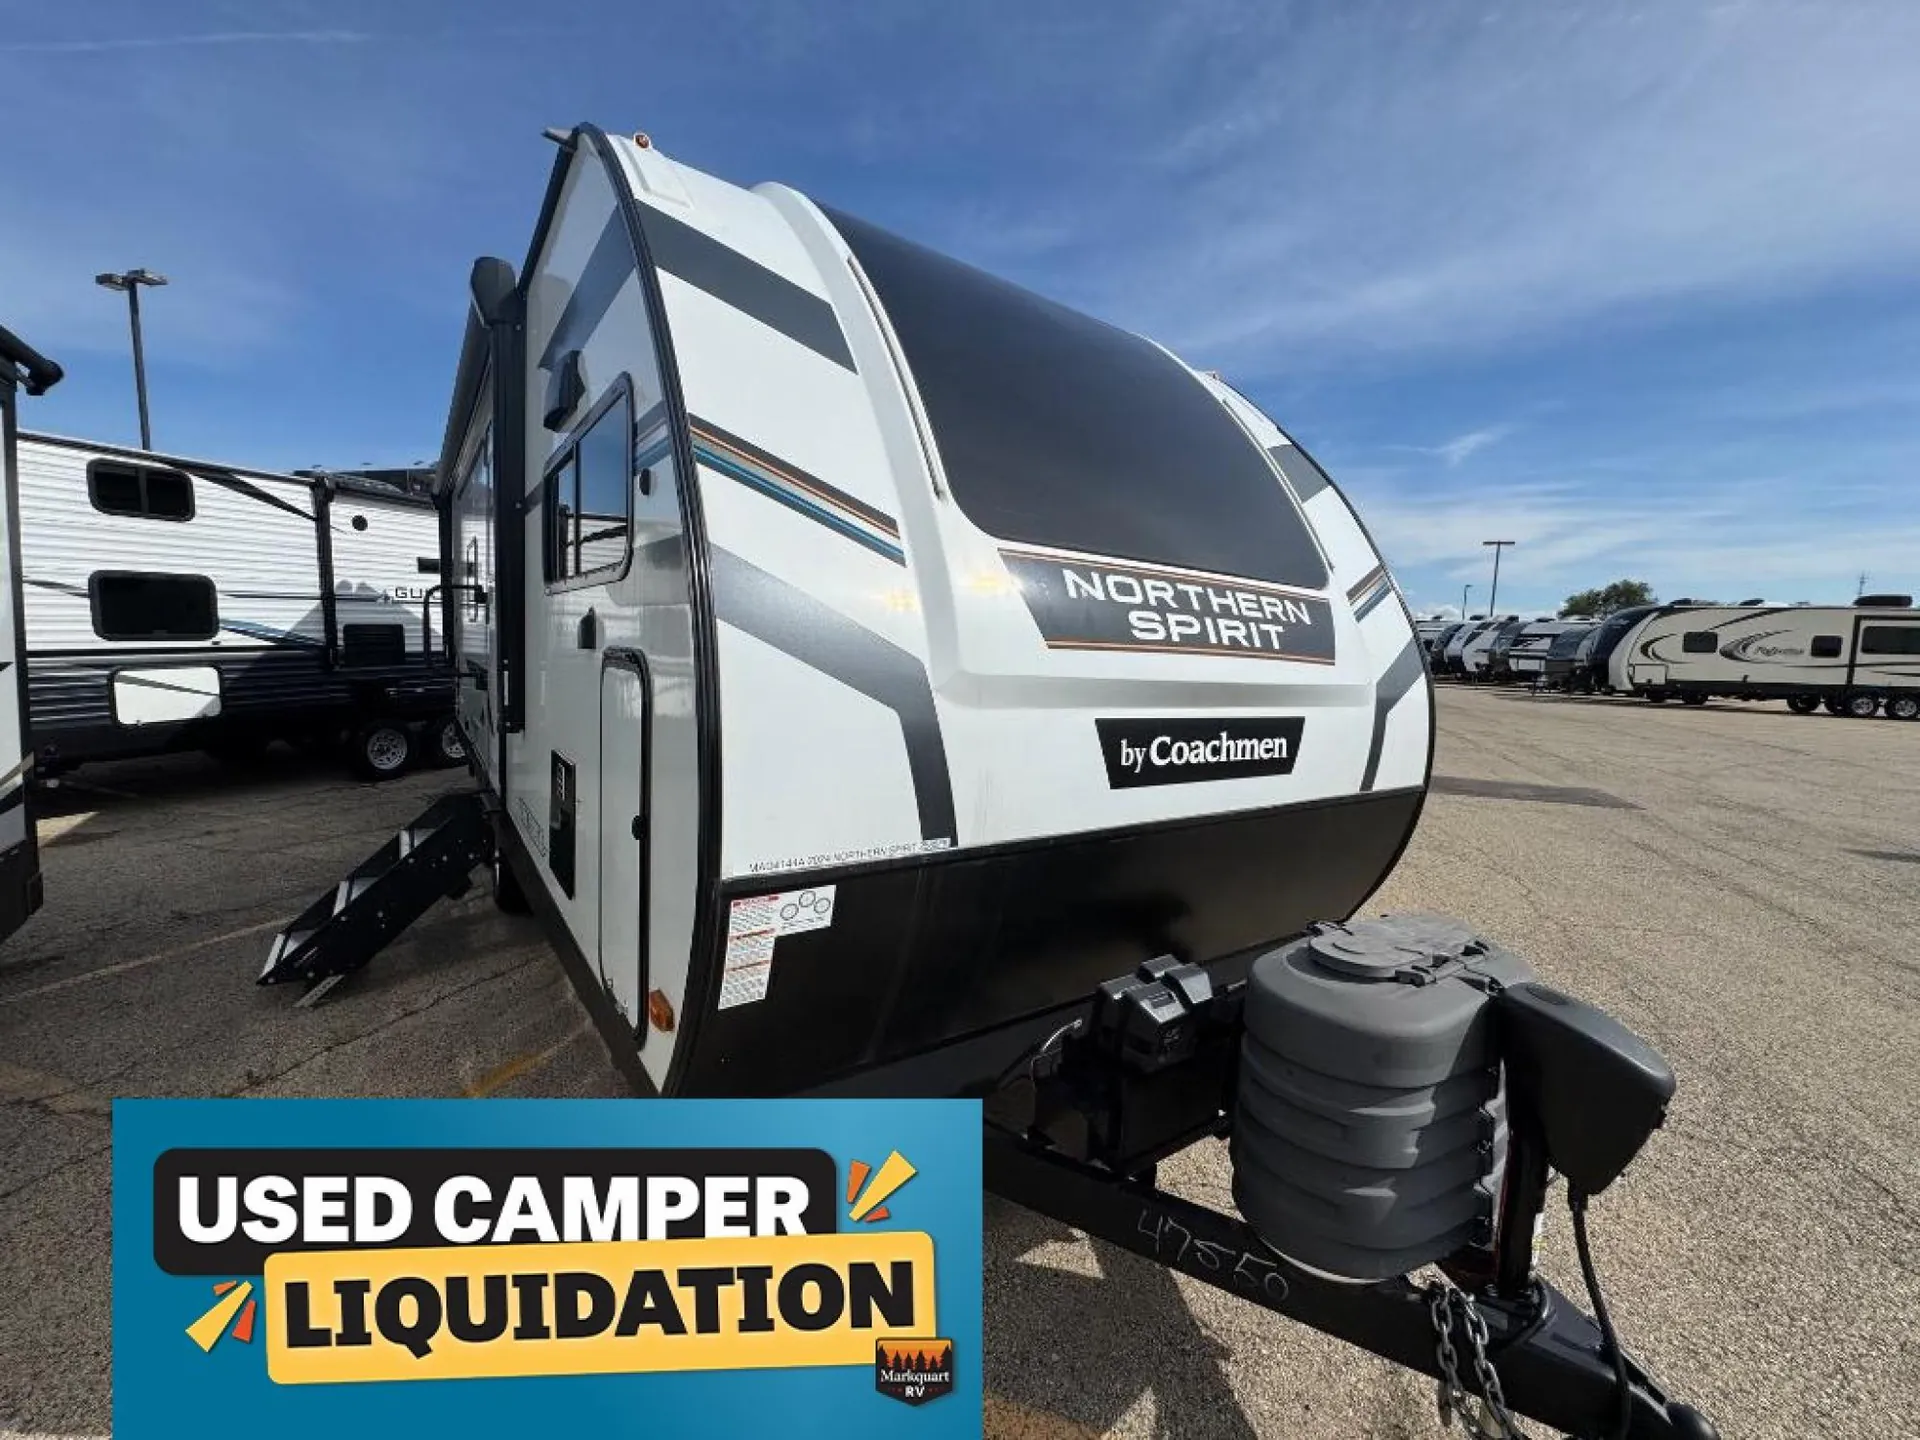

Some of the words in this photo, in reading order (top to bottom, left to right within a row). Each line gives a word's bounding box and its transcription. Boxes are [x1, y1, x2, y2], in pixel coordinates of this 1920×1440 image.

[1062, 569, 1312, 625] NORTHERN
[1128, 610, 1285, 649] SPIRIT
[1120, 739, 1146, 773] by
[1150, 731, 1288, 766] Coachmen
[833, 846, 886, 863] NORTHERN
